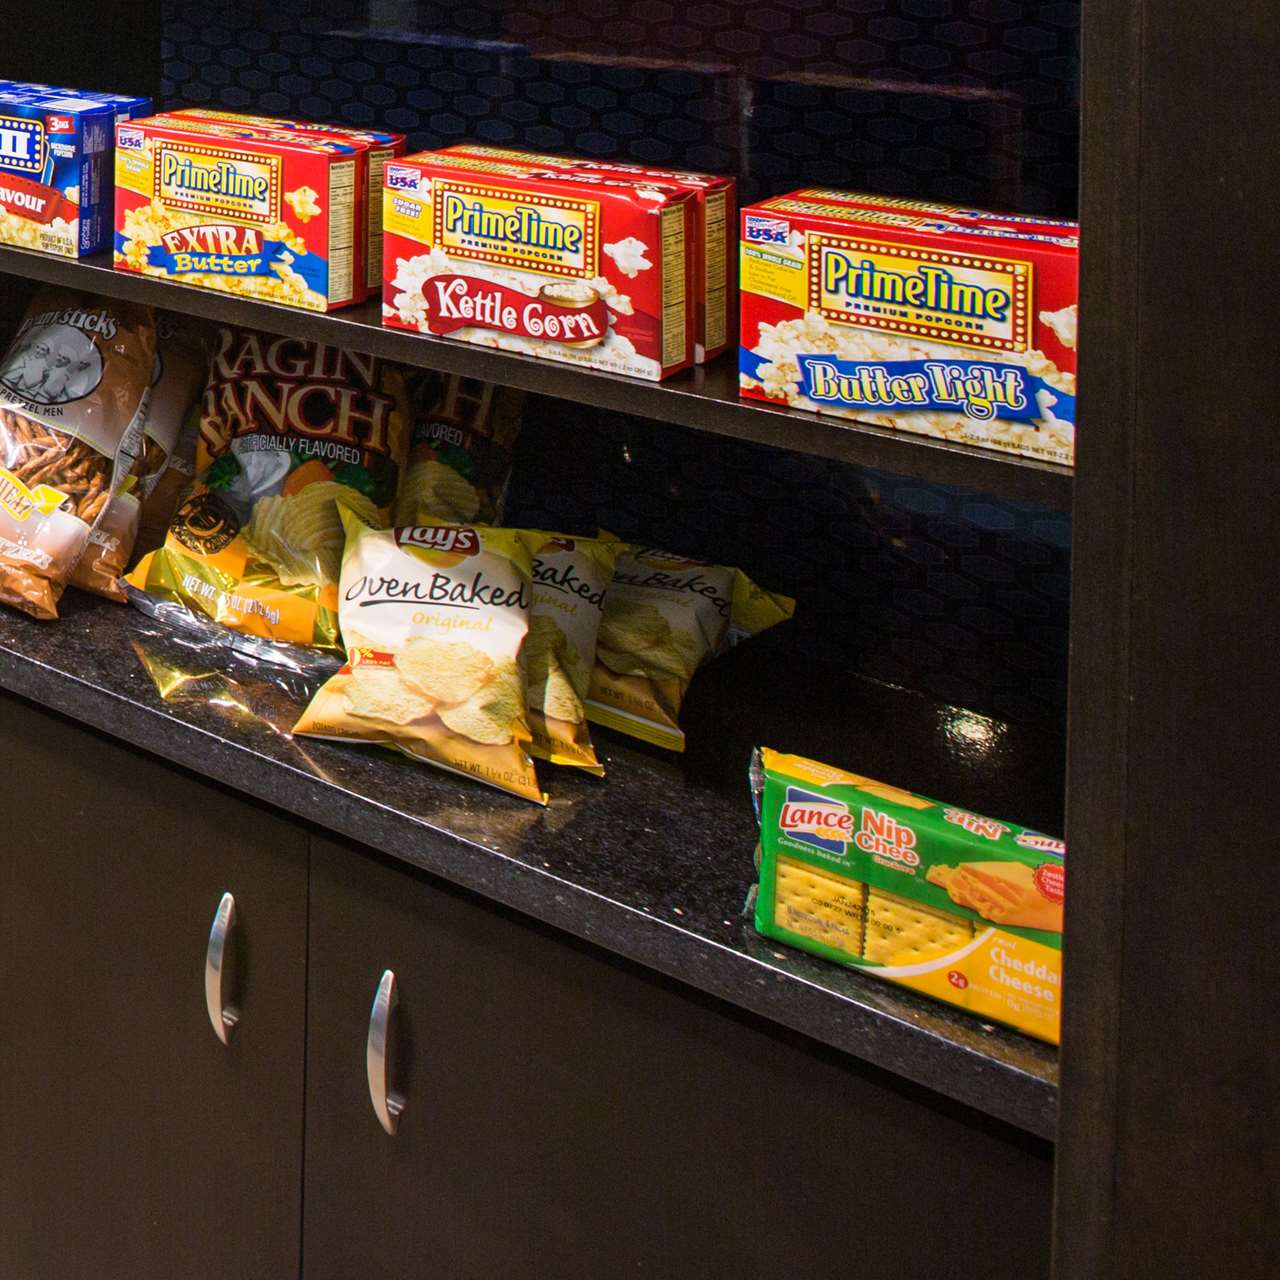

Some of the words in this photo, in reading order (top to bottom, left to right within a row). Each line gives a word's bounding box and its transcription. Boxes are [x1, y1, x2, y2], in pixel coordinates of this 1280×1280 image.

[118, 136, 143, 149] USA
[163, 152, 269, 202] PrimeTime
[389, 174, 420, 190] USA
[175, 190, 212, 203] PREMIUM
[214, 197, 254, 209] POPCORN
[445, 195, 582, 254] PrimeTime
[747, 226, 787, 244] USA
[161, 225, 260, 256] EXTRA
[460, 238, 509, 254] PREMIUM
[512, 246, 564, 262] POPCORN
[172, 254, 263, 273] Butter
[824, 250, 1012, 321] PrimeTime
[434, 277, 517, 331] Kettle
[522, 302, 601, 340] Corn
[844, 301, 909, 319] PREMIUM
[915, 313, 985, 332] POPCORN
[806, 360, 927, 404] Butter
[927, 363, 1027, 419] Light
[43, 405, 65, 417] MEN
[297, 436, 361, 466] FLAVORED
[399, 526, 475, 552] Lay's
[182, 574, 202, 592] NET
[429, 571, 531, 610] Baked
[411, 610, 495, 634] Original
[780, 803, 854, 830] Lance
[862, 808, 916, 849] Nip
[855, 831, 920, 867] Chee
[989, 946, 1060, 985] Chedda
[988, 965, 1056, 1002] Cheese
